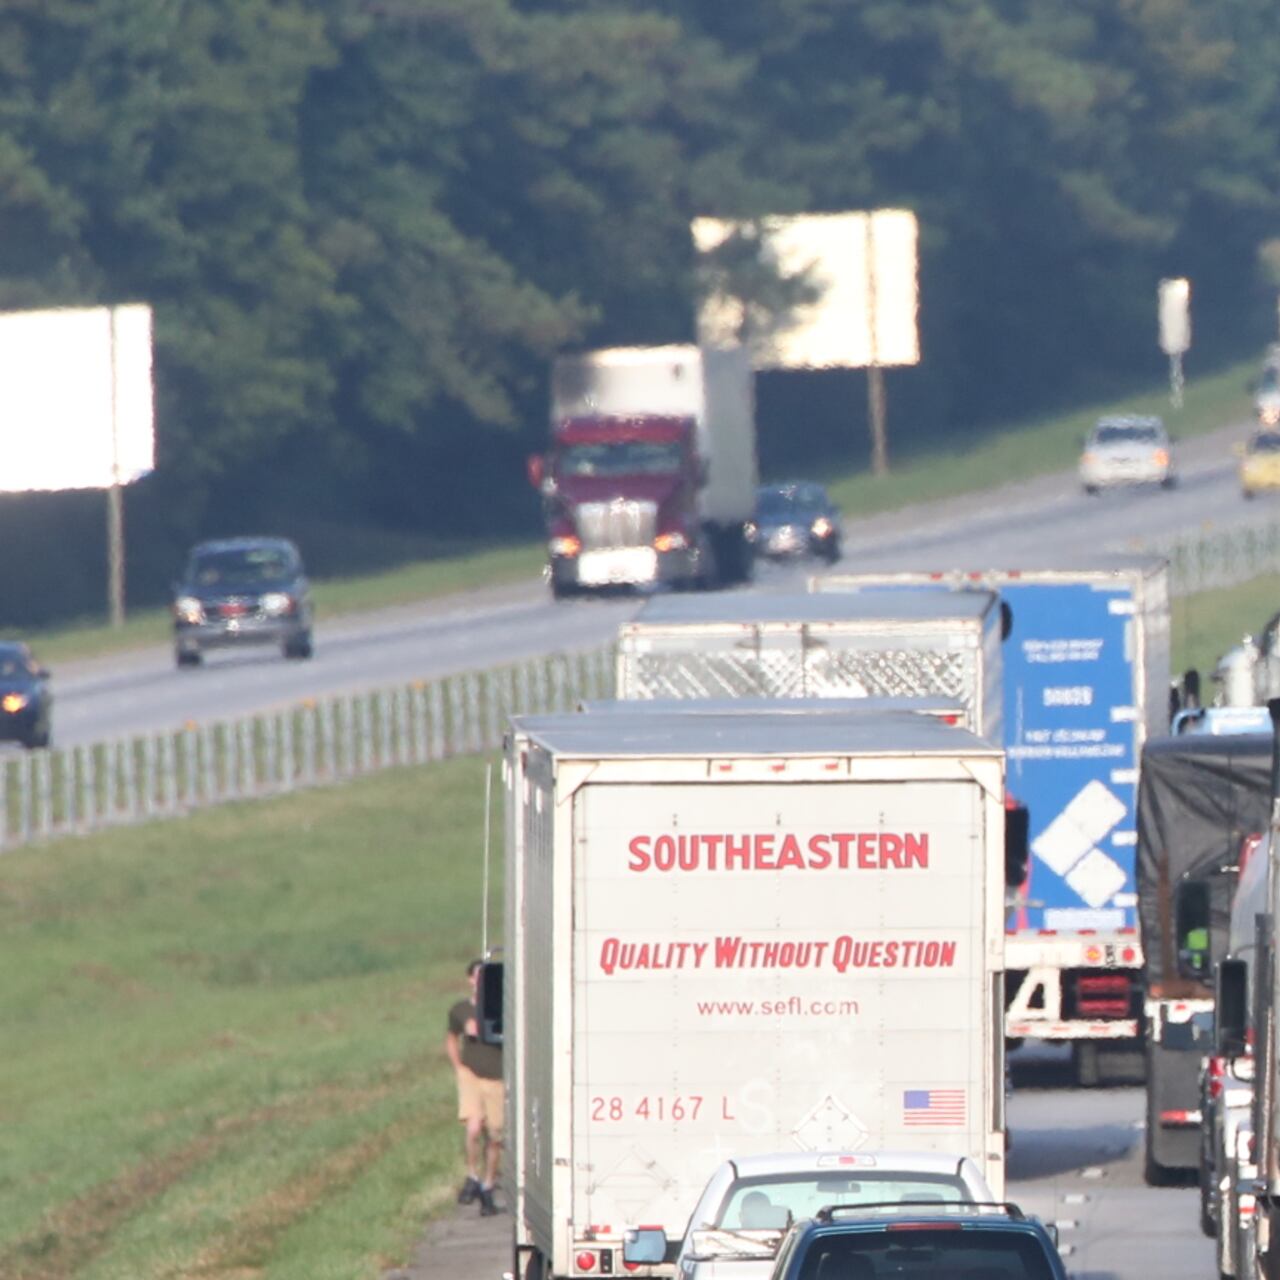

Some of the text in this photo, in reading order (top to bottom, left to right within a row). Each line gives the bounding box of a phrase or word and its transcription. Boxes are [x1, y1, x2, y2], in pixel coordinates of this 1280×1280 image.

[628, 833, 929, 872] SOUTHEASTERN
[600, 935, 957, 975] QUALITY WITHOUT QUESTION
[697, 996, 860, 1017] www.sefl.com
[591, 1096, 736, 1121] 28 4167 L
